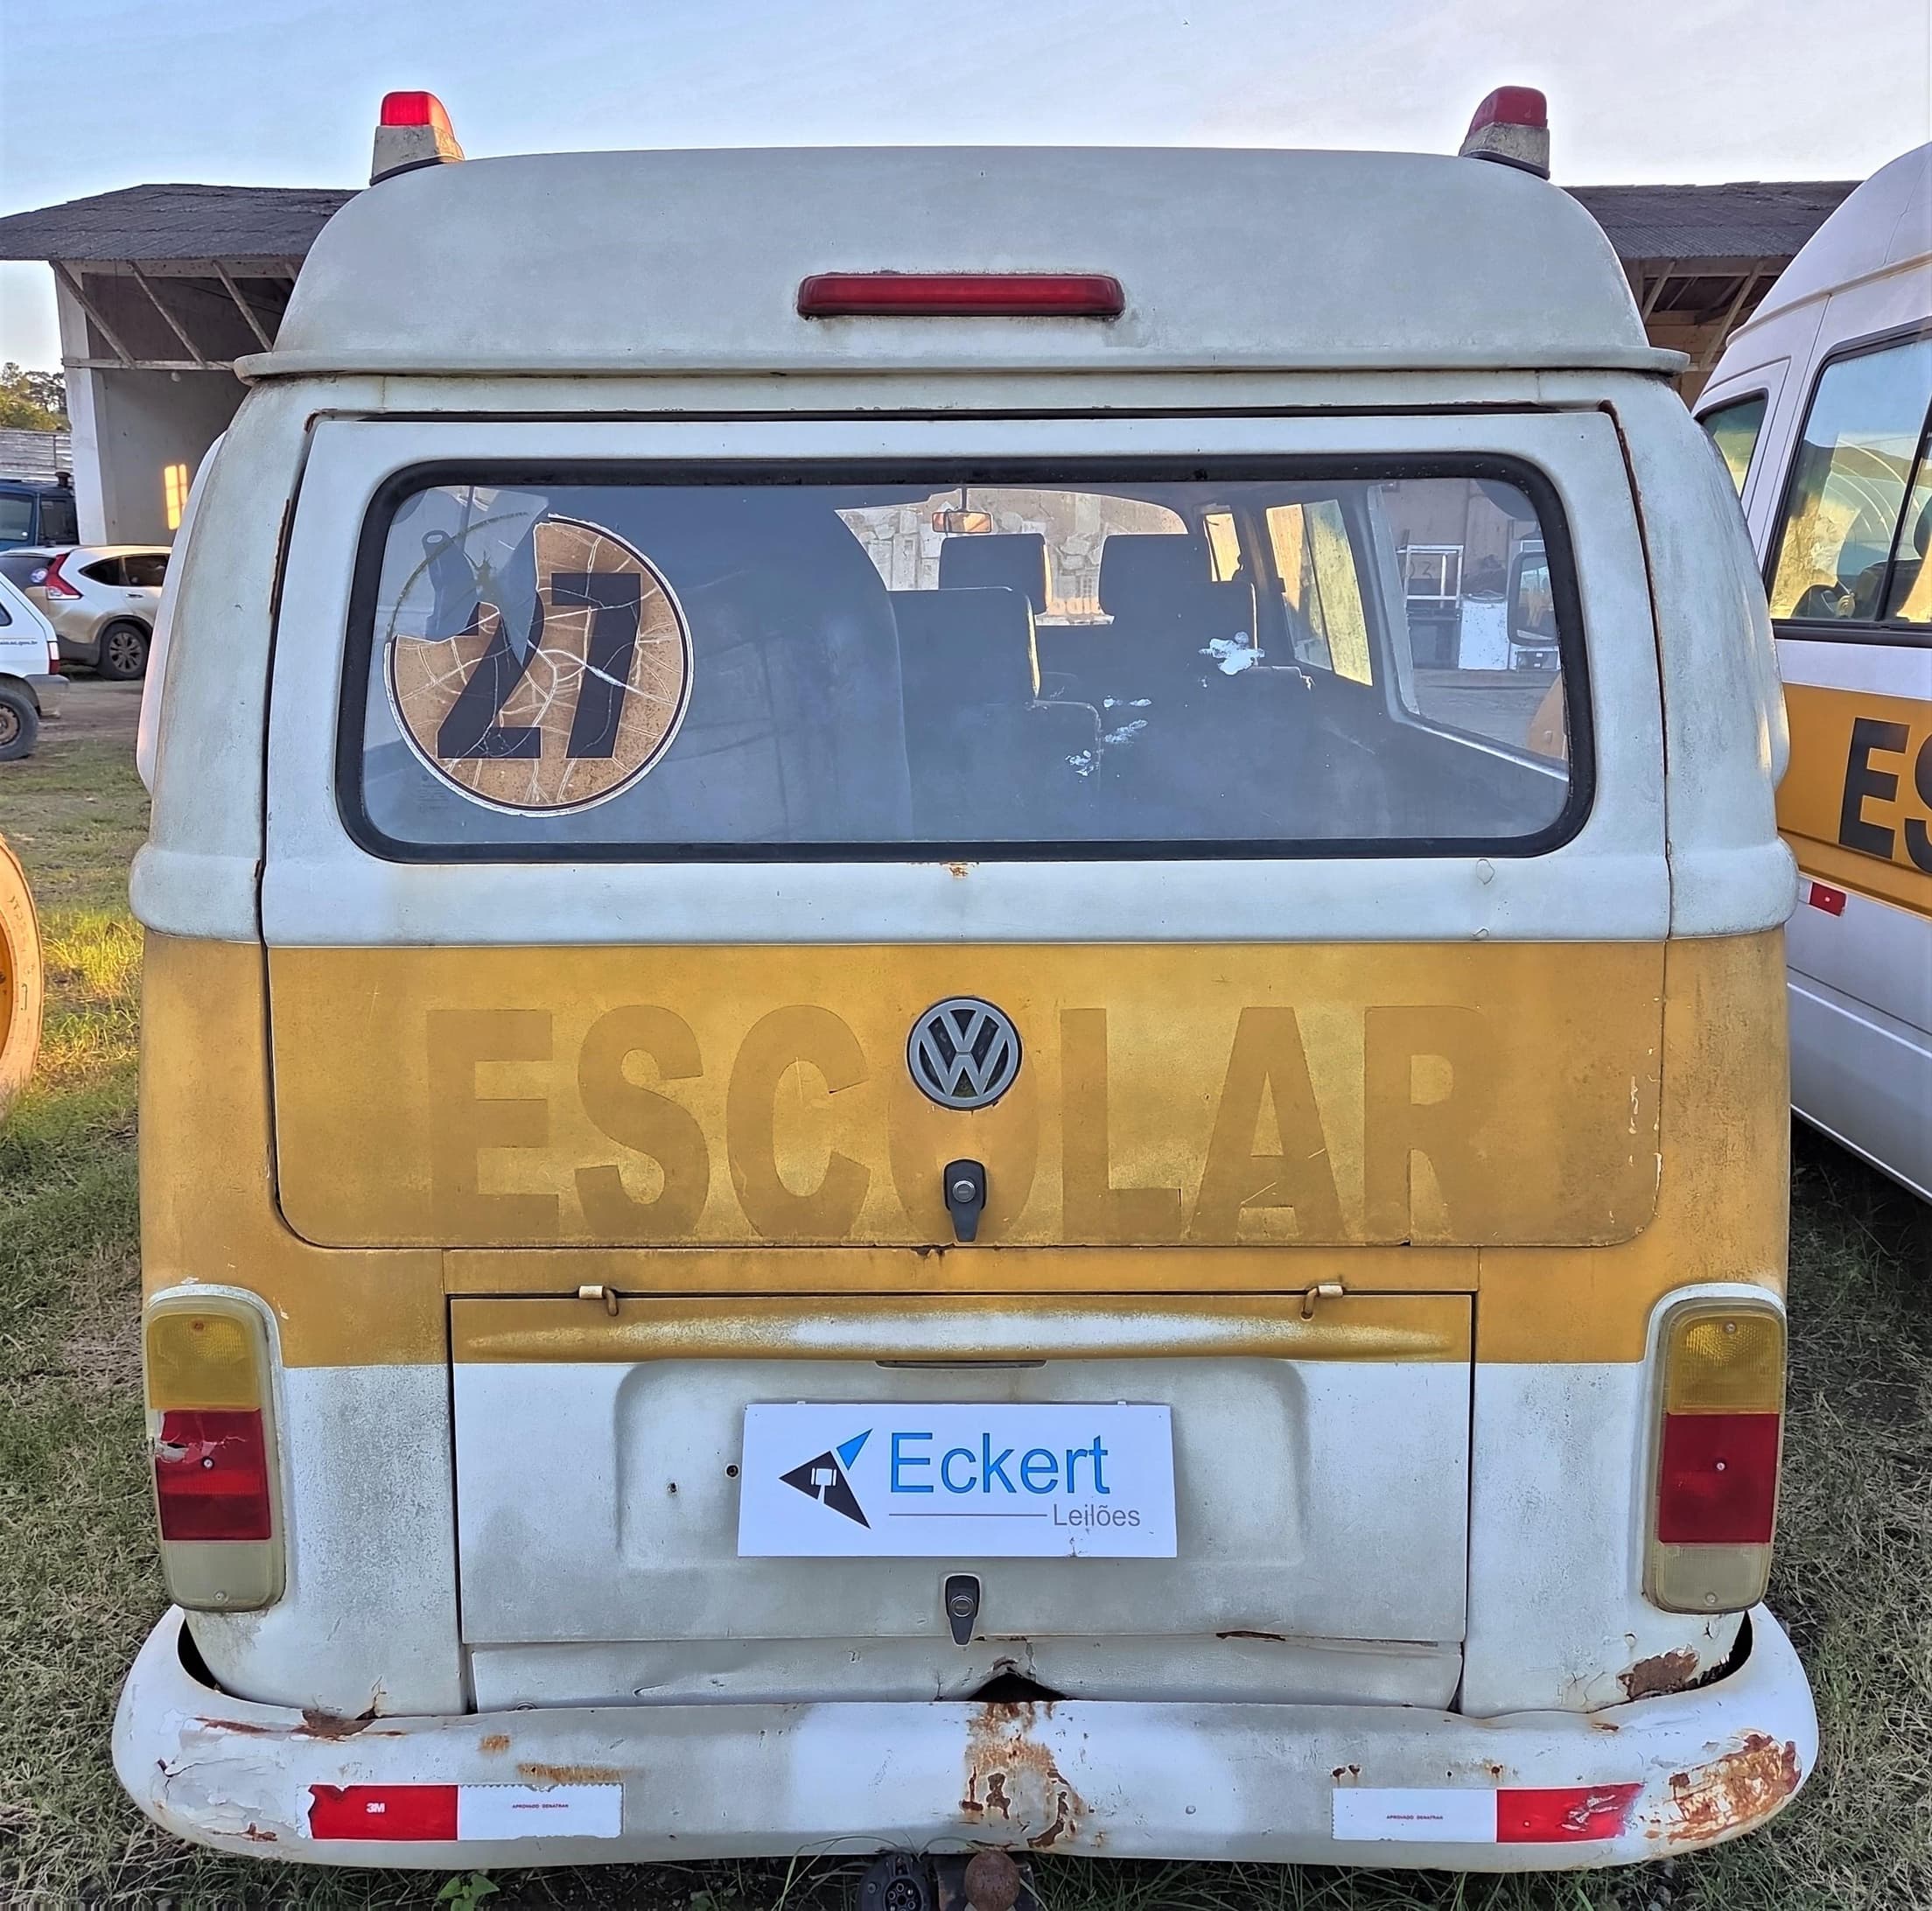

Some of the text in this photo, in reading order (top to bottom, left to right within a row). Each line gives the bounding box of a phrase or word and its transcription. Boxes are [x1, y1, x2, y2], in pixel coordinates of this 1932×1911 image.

[437, 571, 641, 759] 27
[914, 1002, 1017, 1104] VW
[427, 1005, 1498, 1242] ESCOLAR
[889, 1432, 1112, 1495] Eckert
[1052, 1503, 1141, 1528] Leilões
[366, 1802, 386, 1814] 3M
